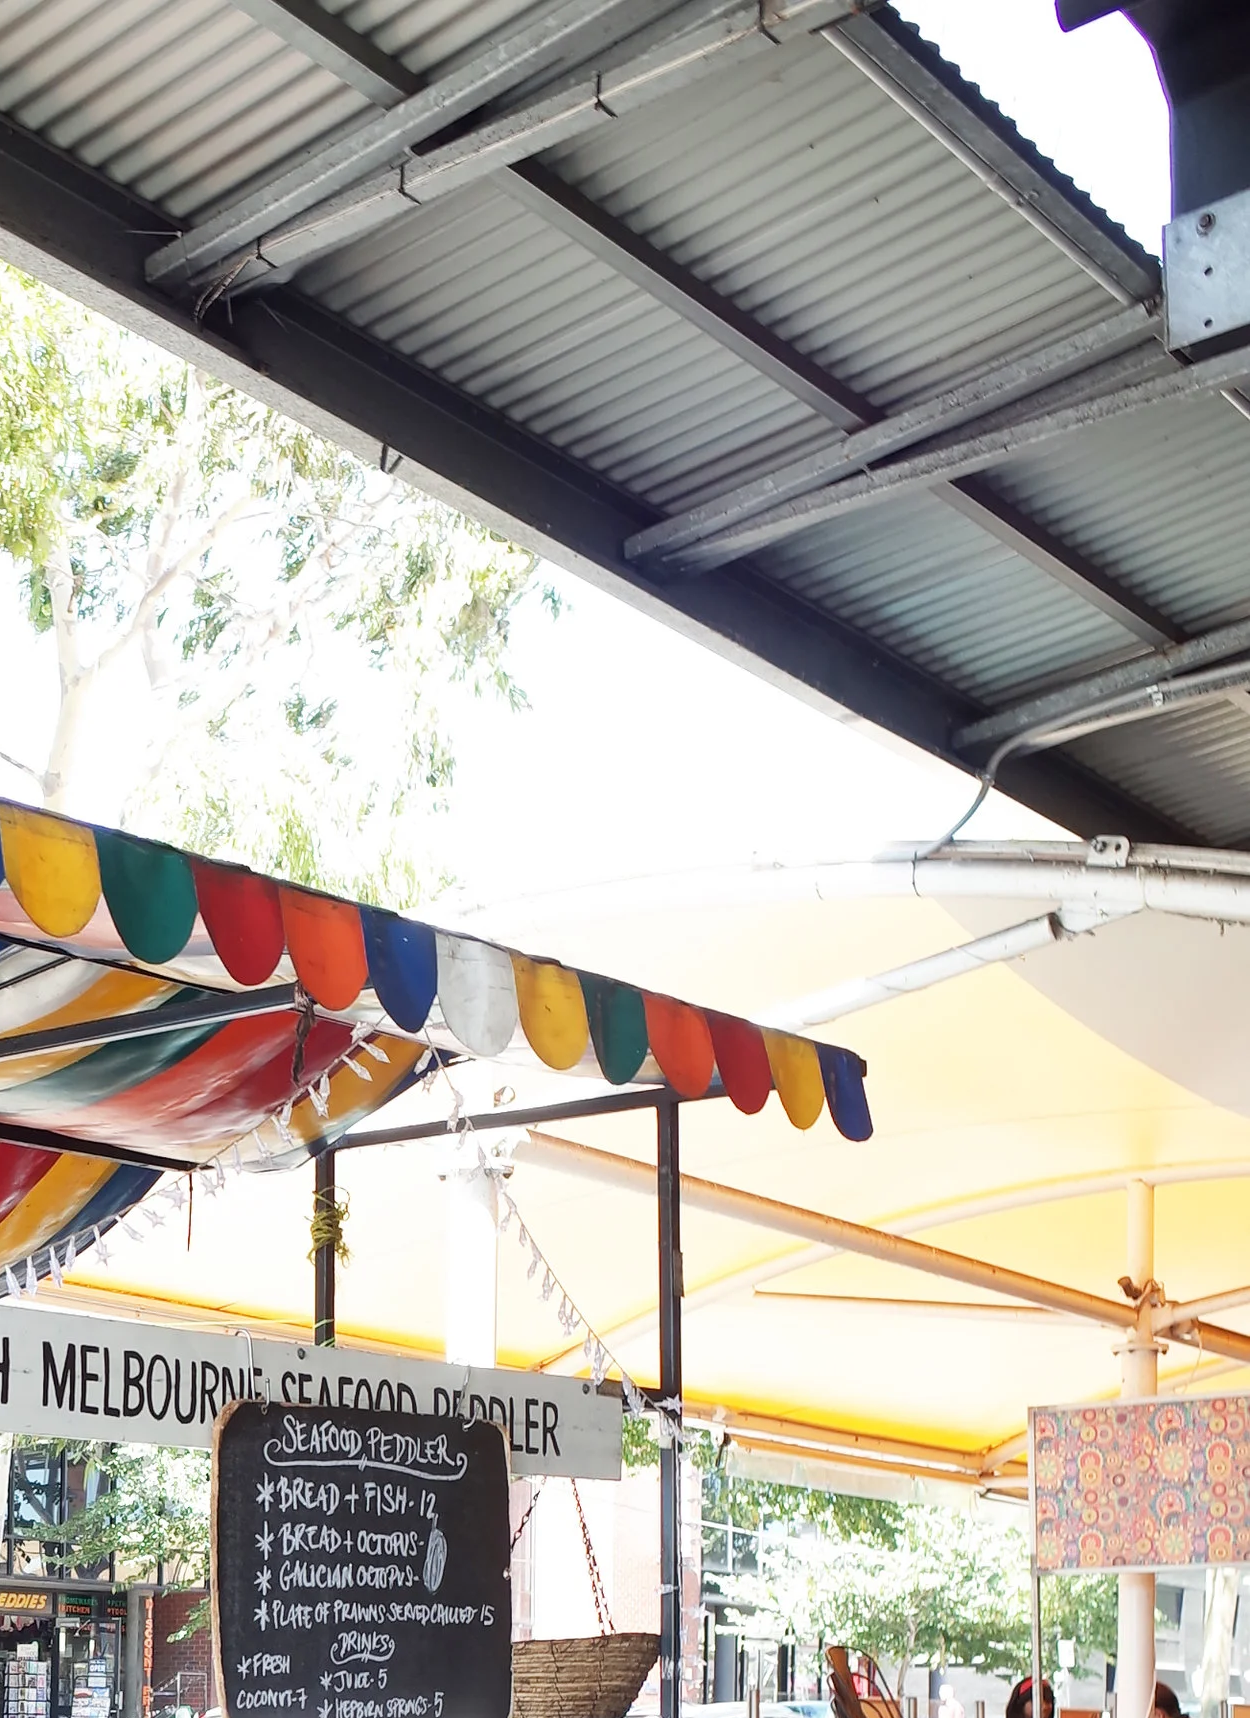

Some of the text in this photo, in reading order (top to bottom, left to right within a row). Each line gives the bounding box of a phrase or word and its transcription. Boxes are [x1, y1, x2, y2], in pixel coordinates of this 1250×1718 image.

[282, 1414, 454, 1466] SEAFOOD PEDDLER
[276, 1475, 340, 1515] BREAD
[277, 1523, 342, 1556] BREAD
[279, 1560, 354, 1592] GALICIAN
[272, 1600, 313, 1629] PLATE
[315, 1602, 331, 1624] OF
[334, 1600, 386, 1625] PRAWNS
[480, 1604, 495, 1627] 15
[338, 1631, 389, 1657] DRINKS
[253, 1652, 291, 1678] FRESH
[378, 1669, 388, 1690] 5
